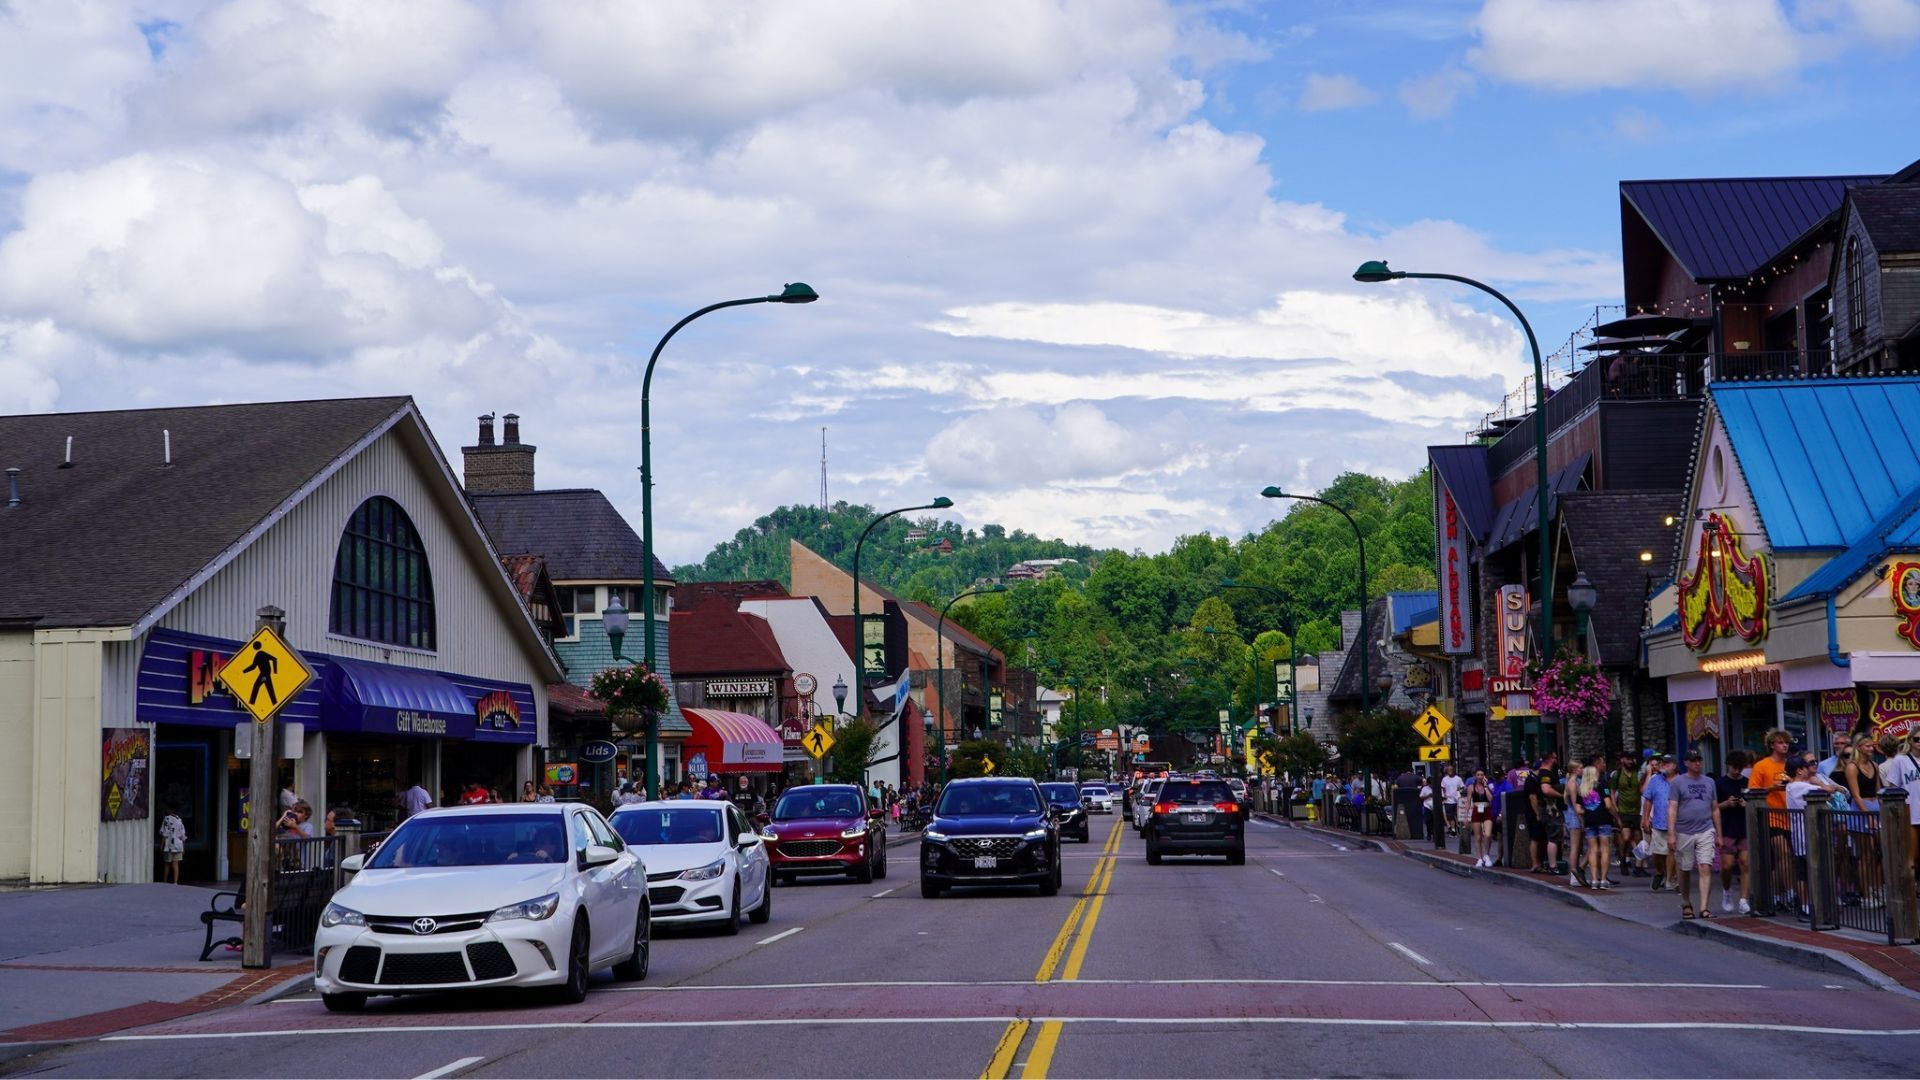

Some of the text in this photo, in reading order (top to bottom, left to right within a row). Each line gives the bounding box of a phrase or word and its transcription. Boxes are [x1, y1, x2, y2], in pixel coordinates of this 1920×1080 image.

[1507, 592, 1525, 651] SUN
[711, 683, 767, 693] WINERY
[1882, 697, 1919, 712] OGLE
[396, 711, 447, 734] Gift Warehouse
[585, 746, 609, 756] Lids
